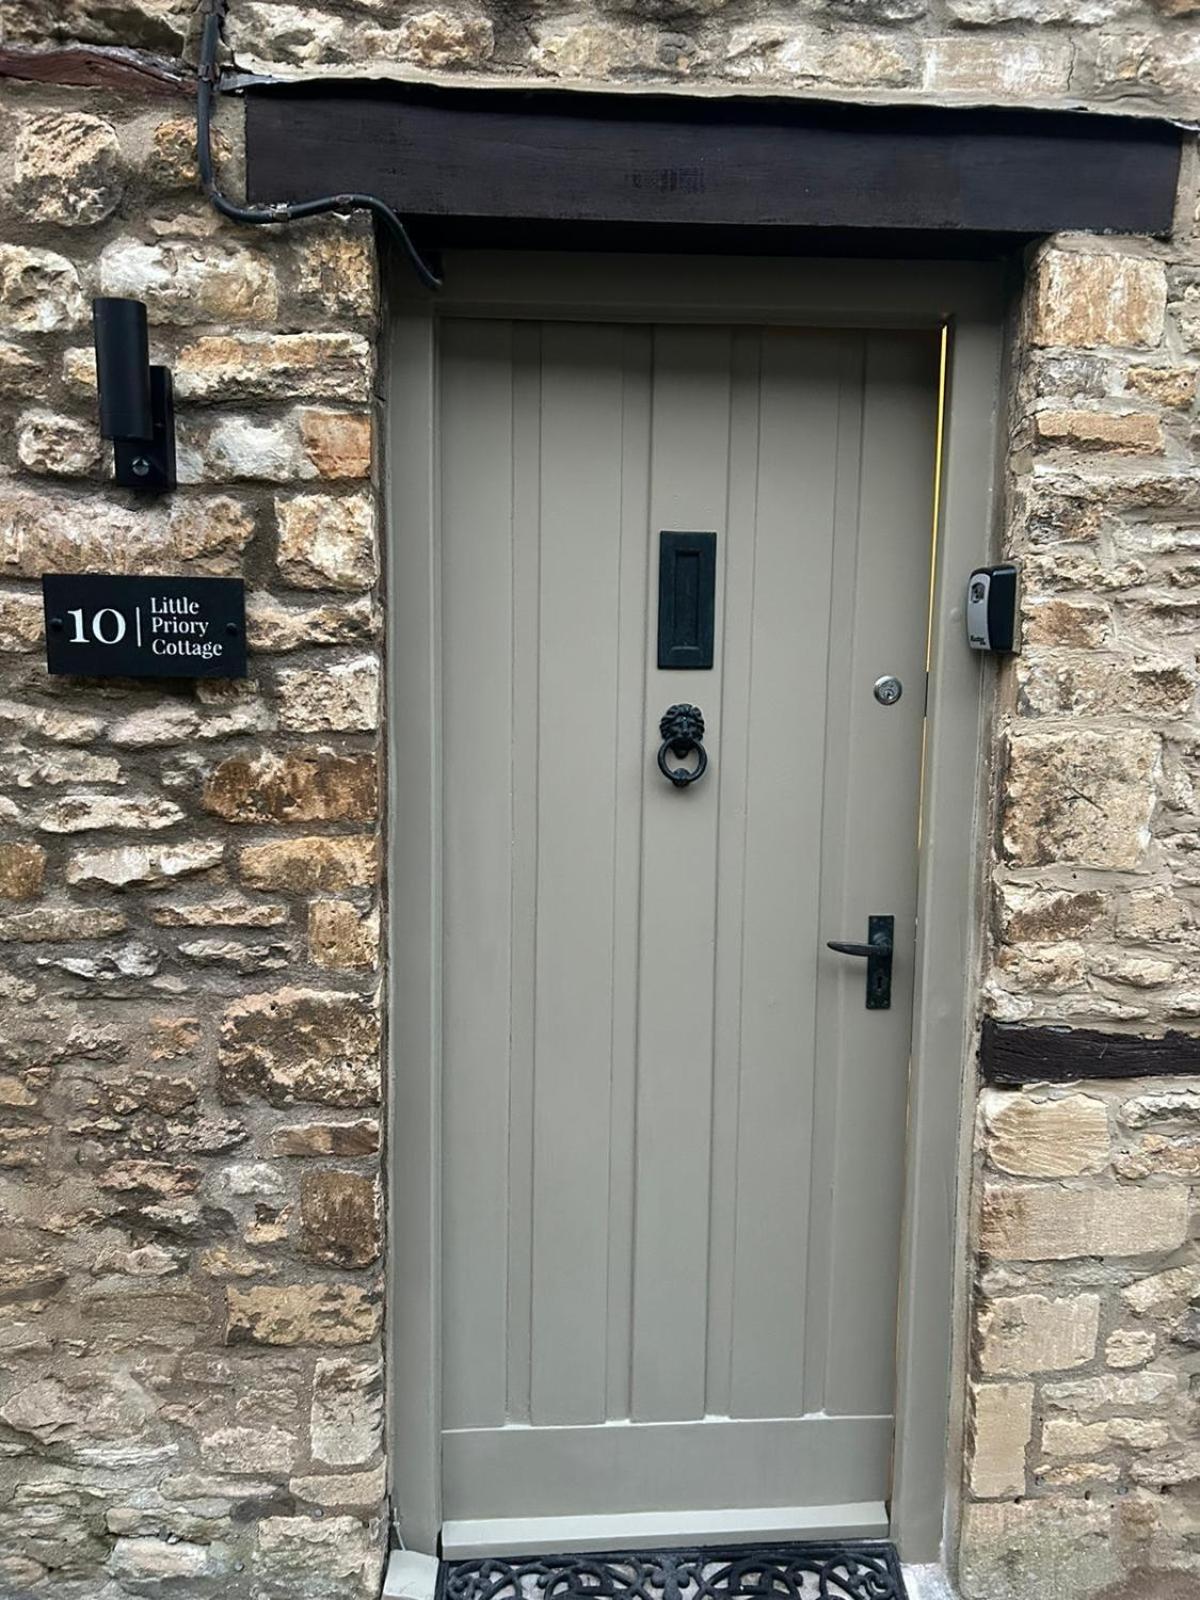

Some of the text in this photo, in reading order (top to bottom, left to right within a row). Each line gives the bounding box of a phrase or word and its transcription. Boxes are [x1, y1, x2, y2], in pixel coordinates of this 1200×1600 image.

[150, 597, 200, 615] Little
[67, 608, 126, 644] 10
[151, 617, 209, 637] Priory
[152, 638, 223, 659] Cottage
